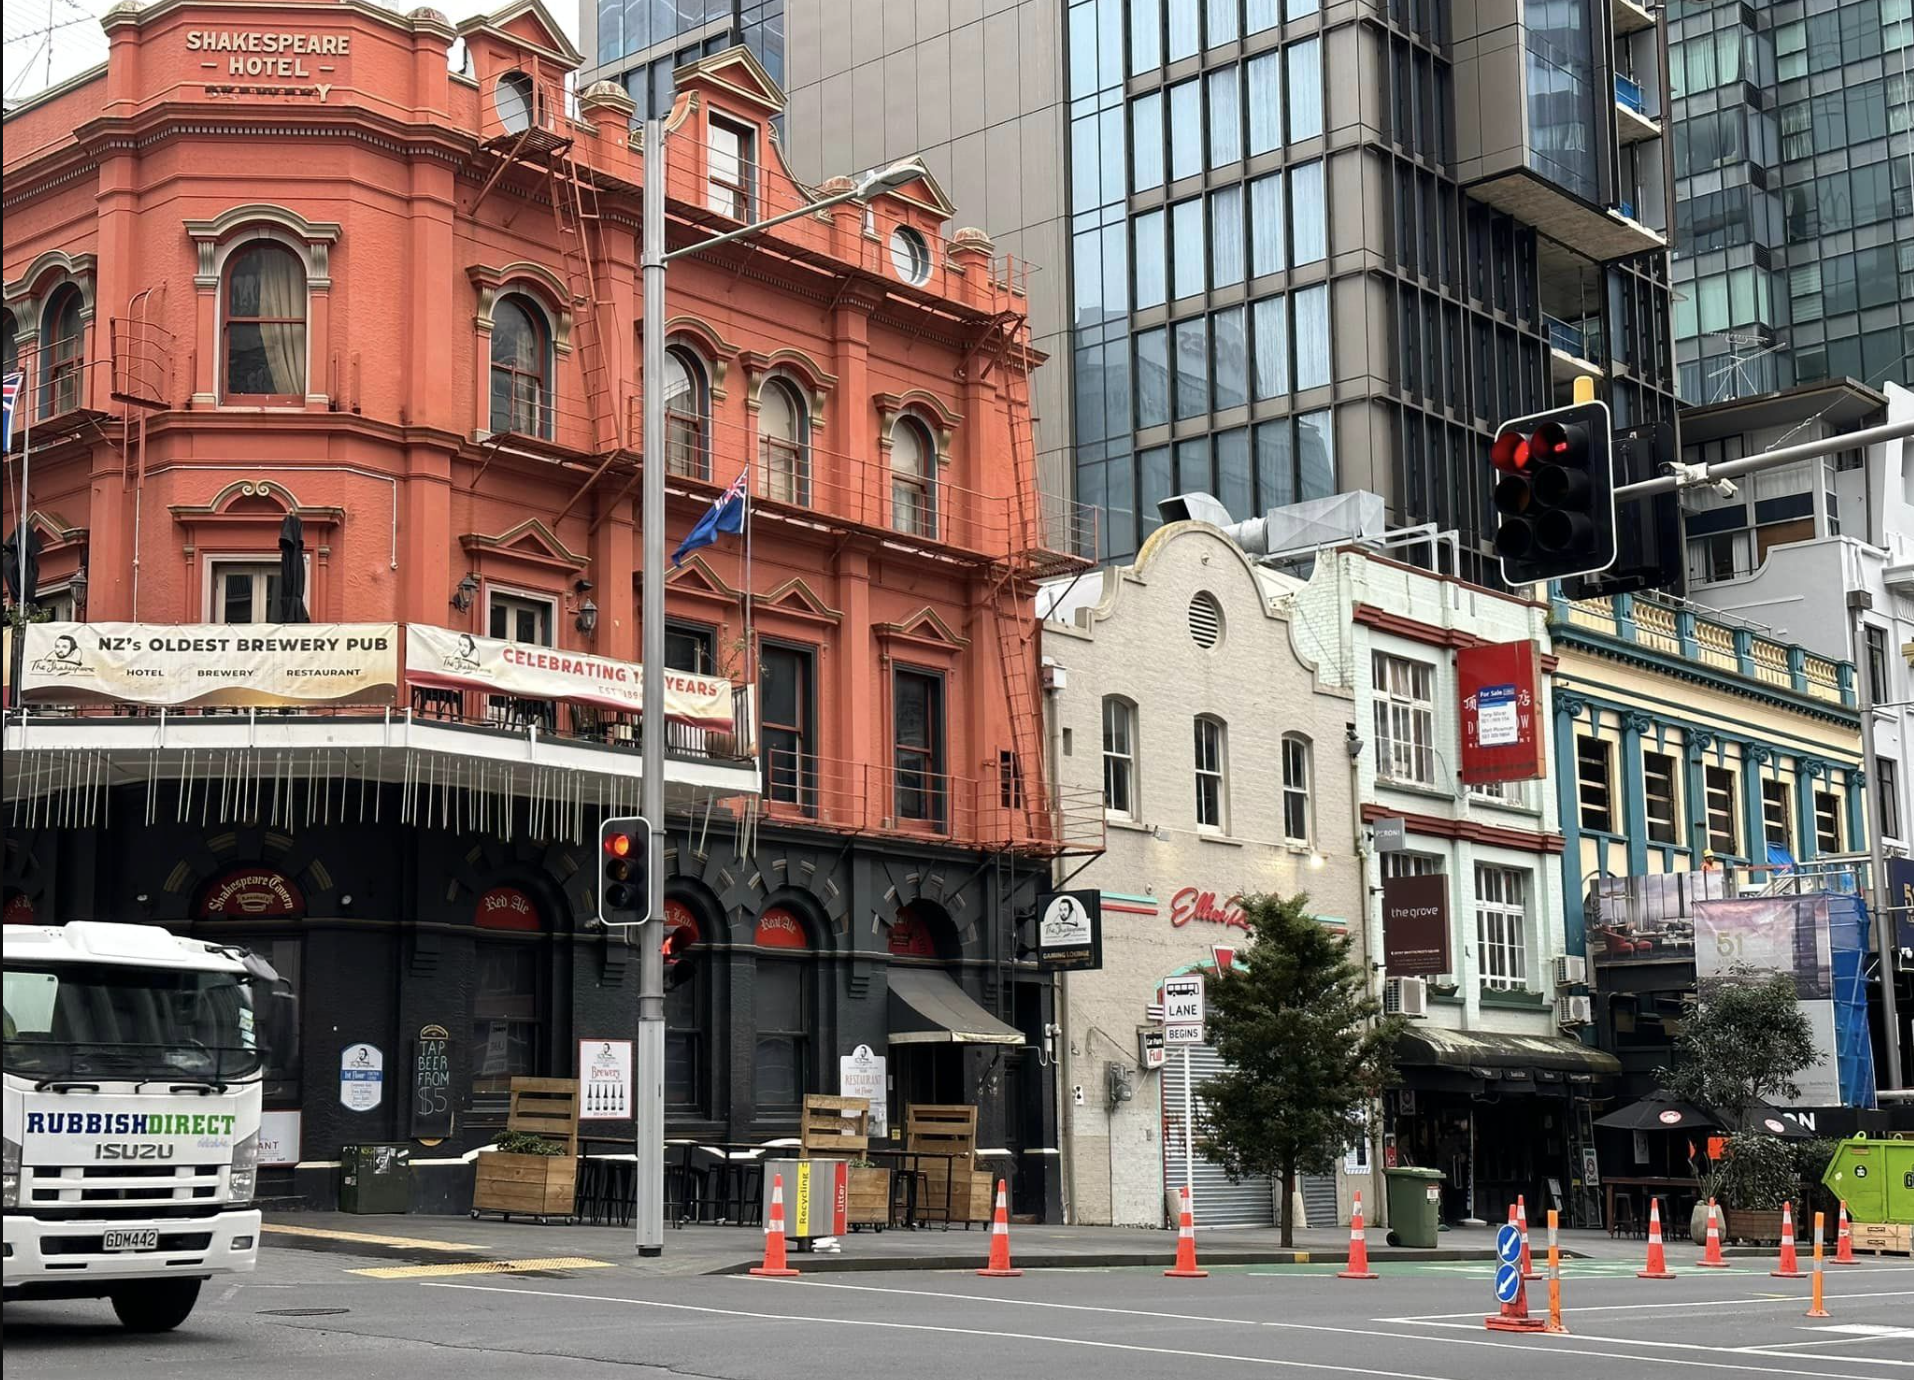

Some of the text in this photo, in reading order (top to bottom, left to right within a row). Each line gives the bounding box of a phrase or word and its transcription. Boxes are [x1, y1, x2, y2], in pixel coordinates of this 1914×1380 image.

[186, 30, 350, 55] SHAKESPEARE
[229, 56, 310, 77] HOTEL
[99, 637, 388, 651] NZ's OLDEST BREWERY PUB
[126, 668, 361, 677] HOTEL BREWERY RESTAURANT
[502, 648, 626, 682] CELEBRATING
[664, 676, 717, 697] YEARS
[1491, 689, 1503, 697] Sale
[208, 875, 269, 912] Shakespeare
[268, 873, 294, 909] Tavern
[1716, 930, 1743, 957] 51
[1043, 950, 1066, 960] GAMING
[1169, 1004, 1198, 1016] LANE
[1169, 1028, 1199, 1039] BEGINS
[419, 1040, 445, 1056] TAP
[418, 1055, 448, 1071] BEER
[418, 1070, 449, 1086] FROM
[845, 1074, 882, 1086] RESTAURANT
[417, 1086, 448, 1115] $5
[26, 1112, 236, 1136] RUBBISHDIRECT
[95, 1143, 174, 1160] ISUZU
[799, 1172, 809, 1224] Recycling
[837, 1183, 846, 1213] Litter
[106, 1231, 156, 1247] GDM442
